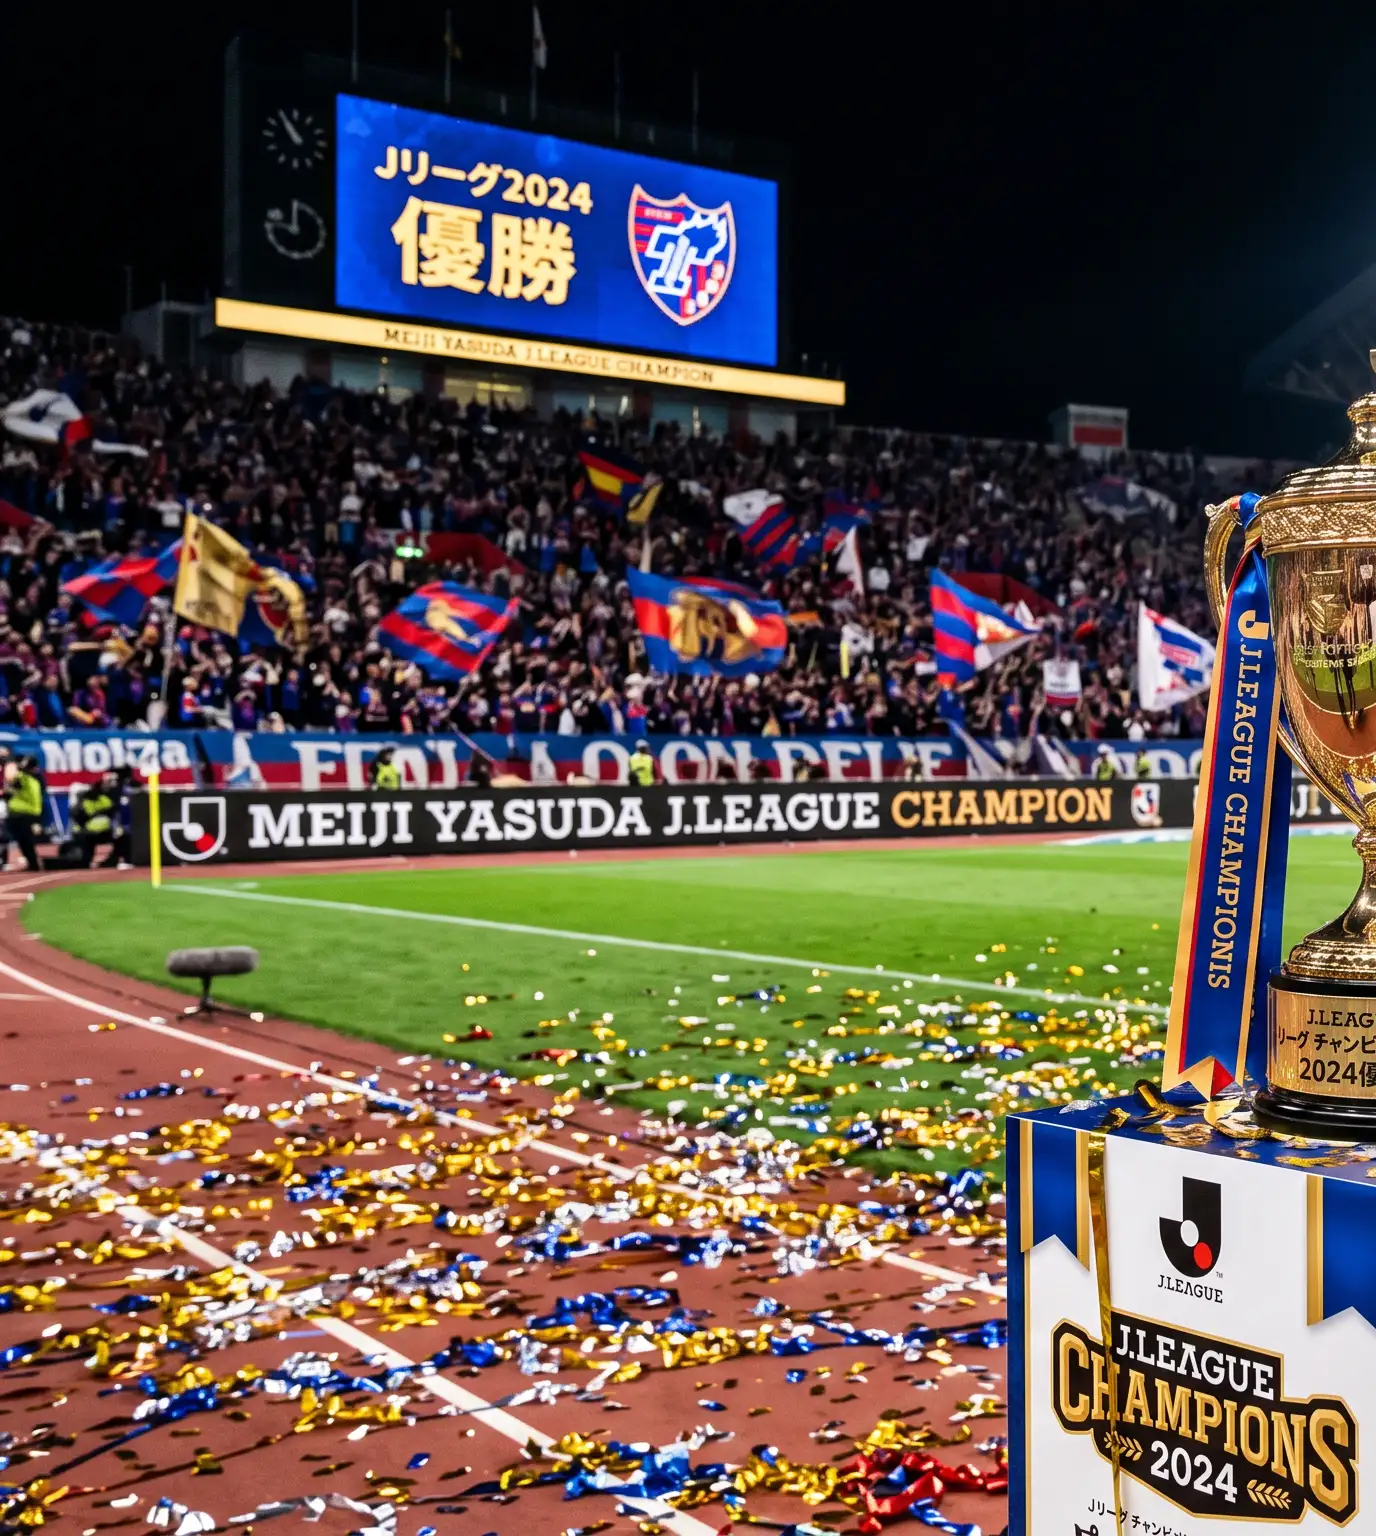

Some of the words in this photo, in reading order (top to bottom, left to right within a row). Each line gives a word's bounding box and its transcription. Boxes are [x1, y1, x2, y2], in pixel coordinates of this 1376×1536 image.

[374, 146, 594, 215] Jリーグ2024
[391, 196, 577, 305] 優勝
[384, 327, 436, 349] MEIJI
[443, 333, 517, 359] YASUDA
[616, 357, 714, 383] CHAMPION
[1229, 644, 1262, 784] J.LEAGUE
[248, 800, 413, 849] MEIJI
[426, 797, 651, 841] YASUDA
[663, 792, 880, 836] J.LEAGUE
[891, 787, 1112, 829] CHAMPION
[1207, 793, 1249, 989] CHAMPIONIS
[1158, 1274, 1223, 1303] J.LEAGUE
[1116, 1324, 1274, 1401] J.LEAGUE
[1059, 1332, 1349, 1512] CHAMPIONS
[1150, 1440, 1238, 1504] 2024
